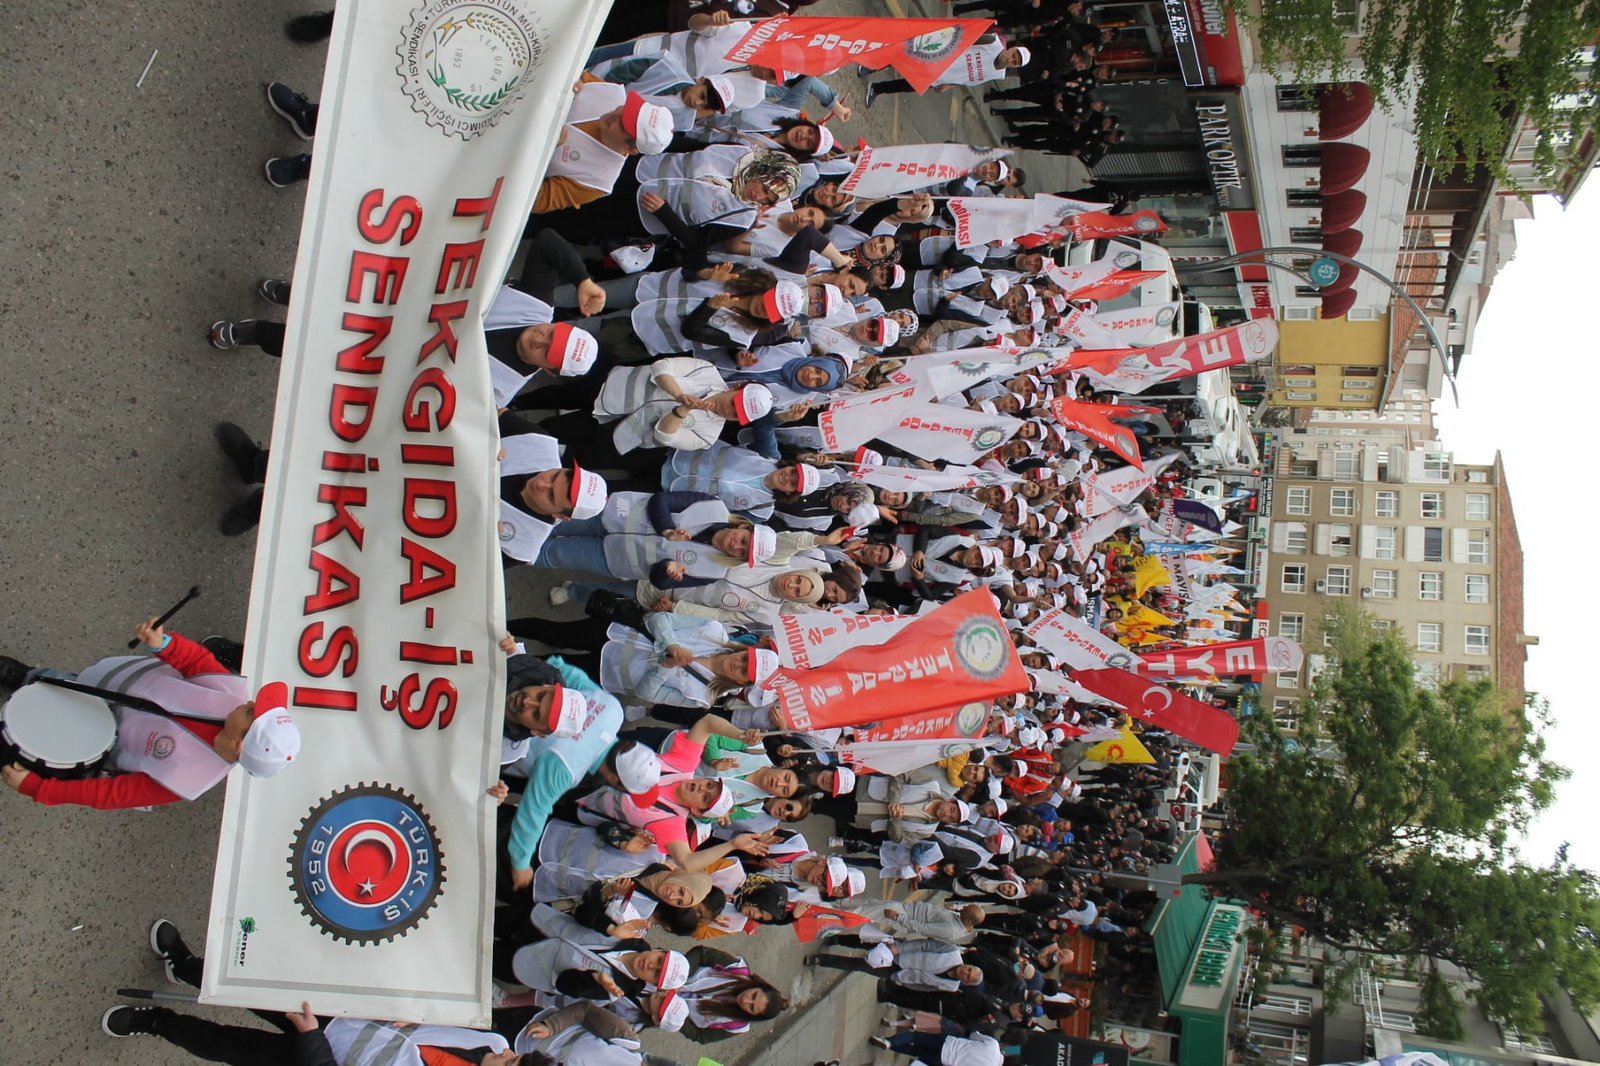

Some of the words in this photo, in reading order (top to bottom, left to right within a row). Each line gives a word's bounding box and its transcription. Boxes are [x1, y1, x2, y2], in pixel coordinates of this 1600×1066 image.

[407, 20, 428, 78] SENDİKASI
[806, 33, 891, 55] KGIDA
[489, 56, 503, 82] GIDA
[1195, 104, 1232, 147] PARK
[841, 150, 874, 192] SENDİKASI
[896, 162, 971, 180] TEKGIDA
[1206, 150, 1246, 190] OPTİK
[820, 400, 845, 451] SEİKASI
[899, 416, 975, 441] TEKGIDA
[292, 187, 424, 713] SENDİKASI
[379, 175, 506, 732] TEKGIDA-İŞ
[1172, 564, 1190, 599] MAYIS
[1027, 609, 1062, 637] SENDİKASI
[1062, 630, 1109, 662] TEKGIDA
[1147, 646, 1255, 676] EYT
[307, 825, 334, 897] 1952
[381, 810, 430, 922] TÜRK-İŞ
[1189, 951, 1230, 987] BABA
[1056, 1042, 1066, 1066] AKAD
